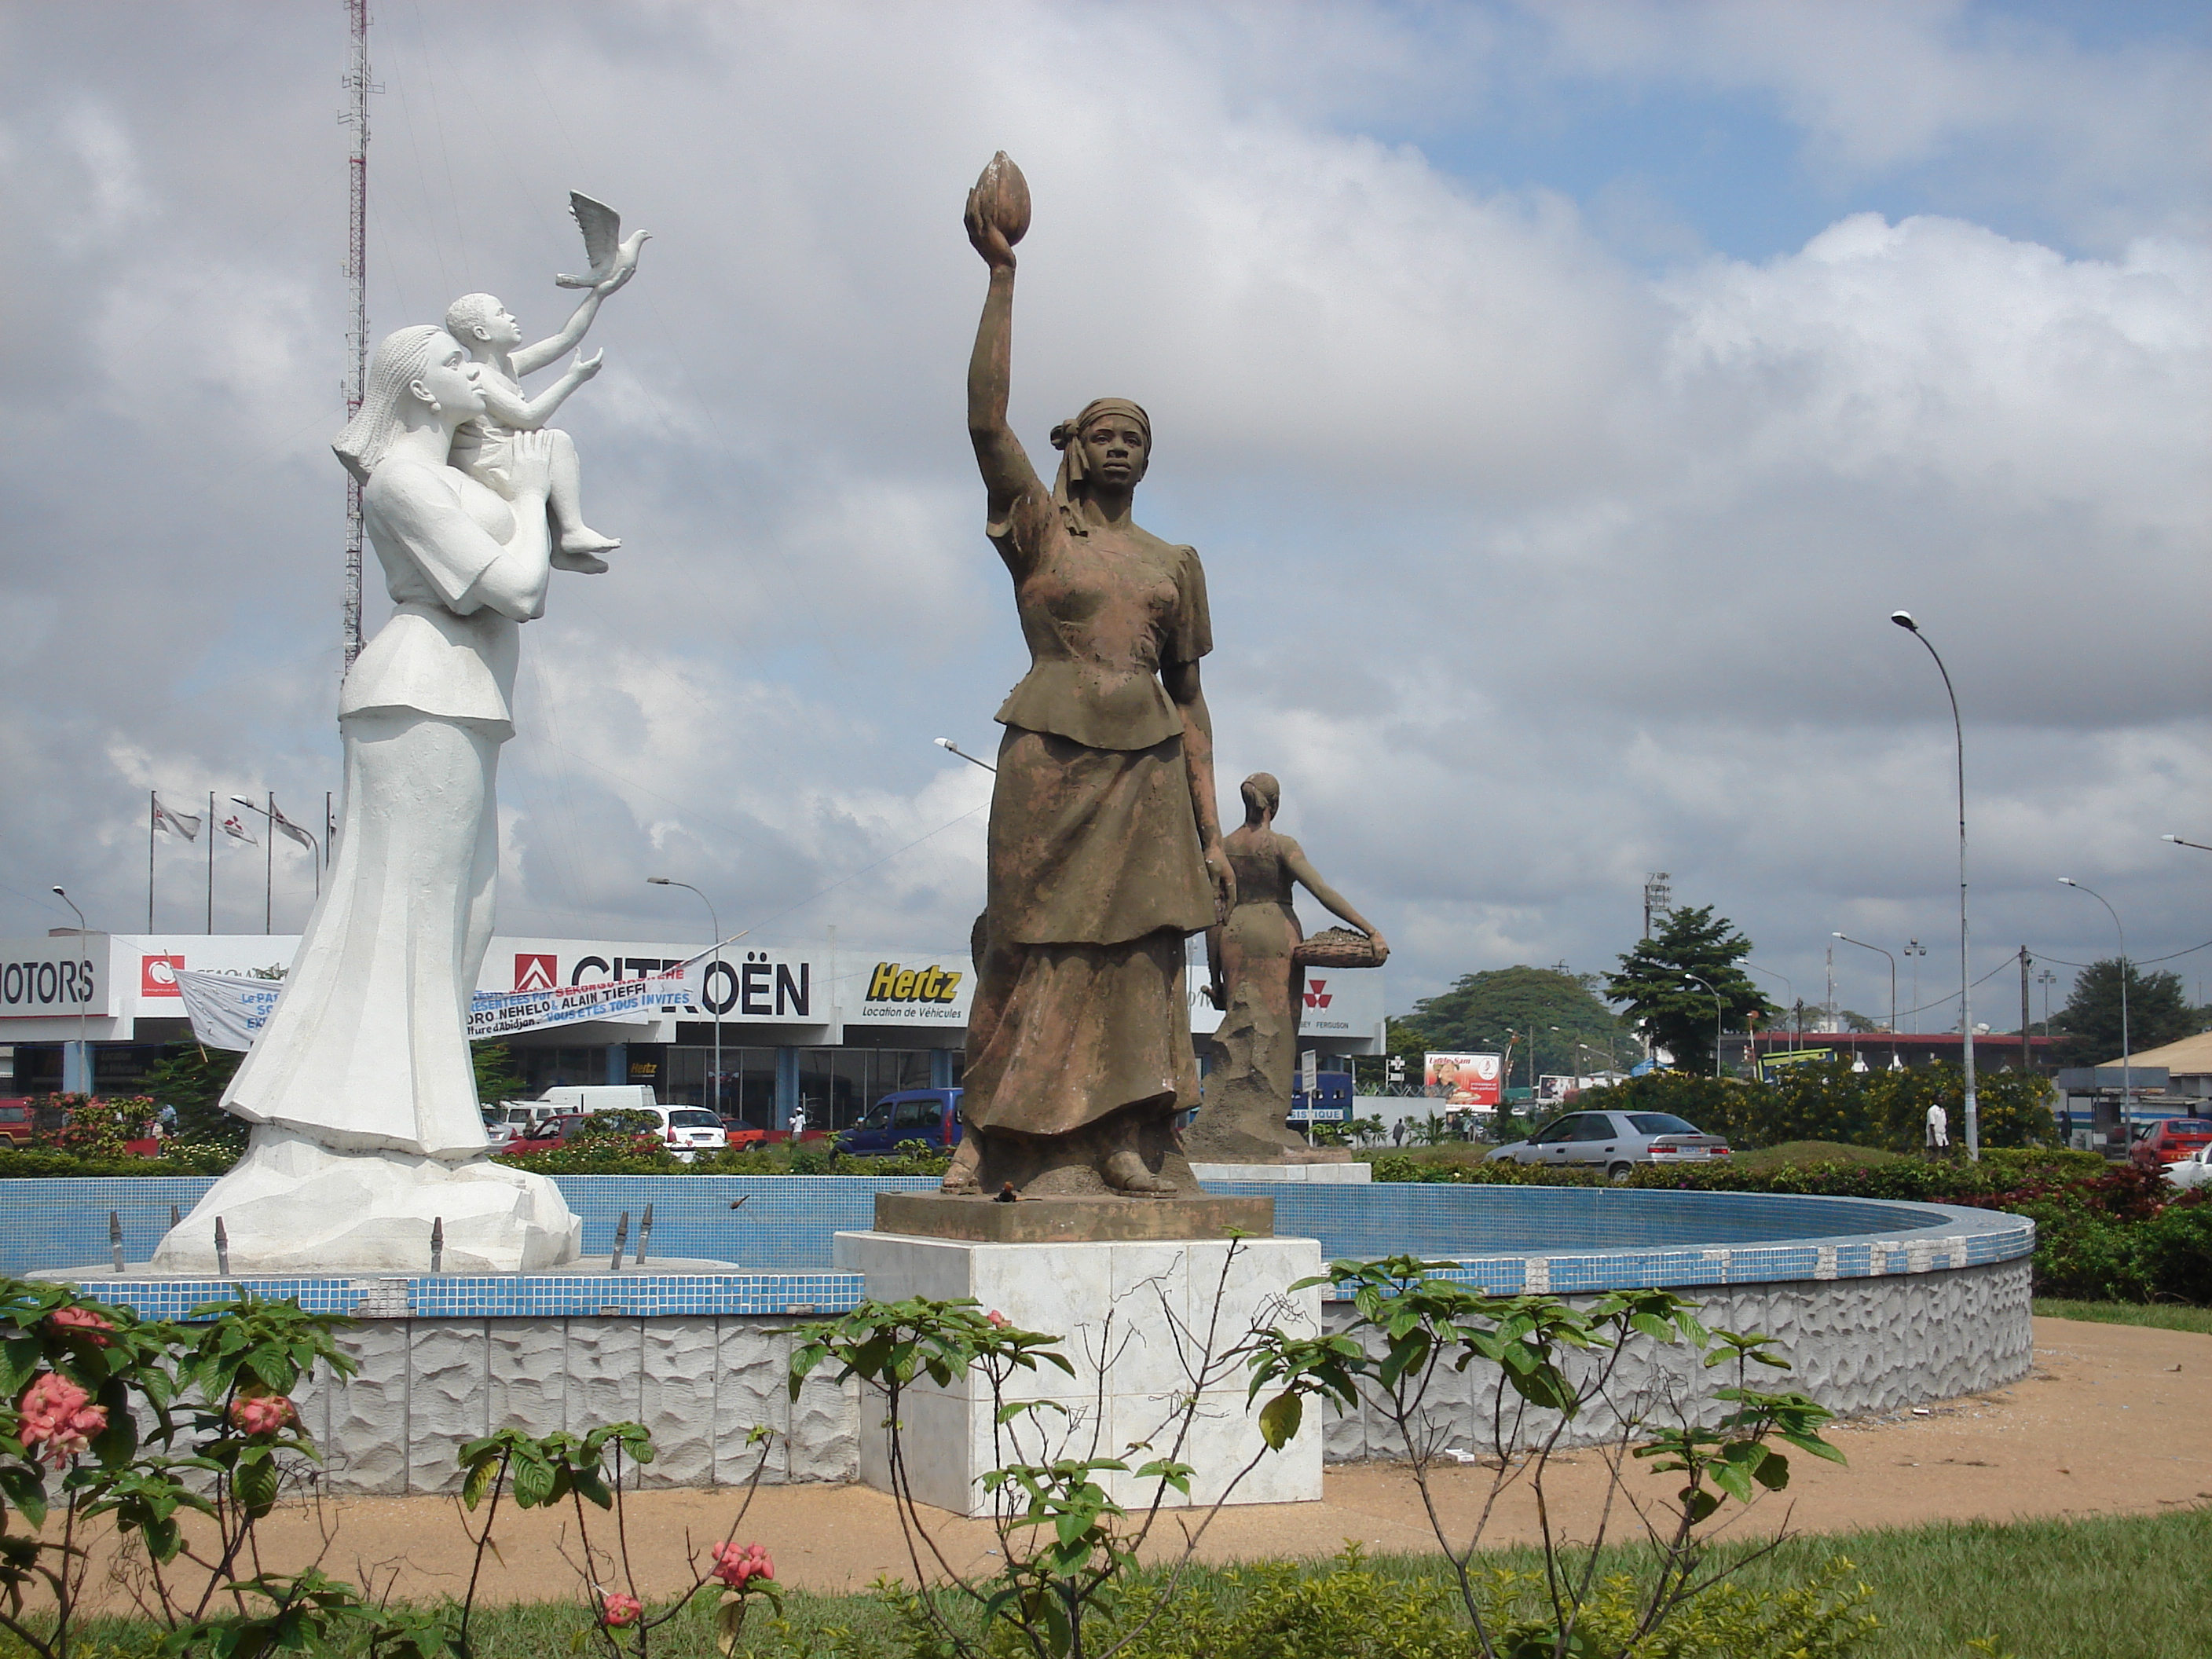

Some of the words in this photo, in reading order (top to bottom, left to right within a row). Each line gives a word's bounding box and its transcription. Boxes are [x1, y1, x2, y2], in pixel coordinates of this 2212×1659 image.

[0, 960, 93, 1004] OTORS
[866, 962, 962, 1003] Hertz
[499, 1001, 550, 1020] NEHELO
[562, 992, 597, 1009] ALAIN
[602, 983, 646, 1001] TIEFFI
[609, 998, 638, 1012] TOUS
[862, 1006, 897, 1016] Location
[903, 1007, 916, 1016] de
[919, 1007, 961, 1018] Véhicules
[631, 1062, 658, 1074] Hertz
[1290, 1110, 1340, 1119] GISIQUE
